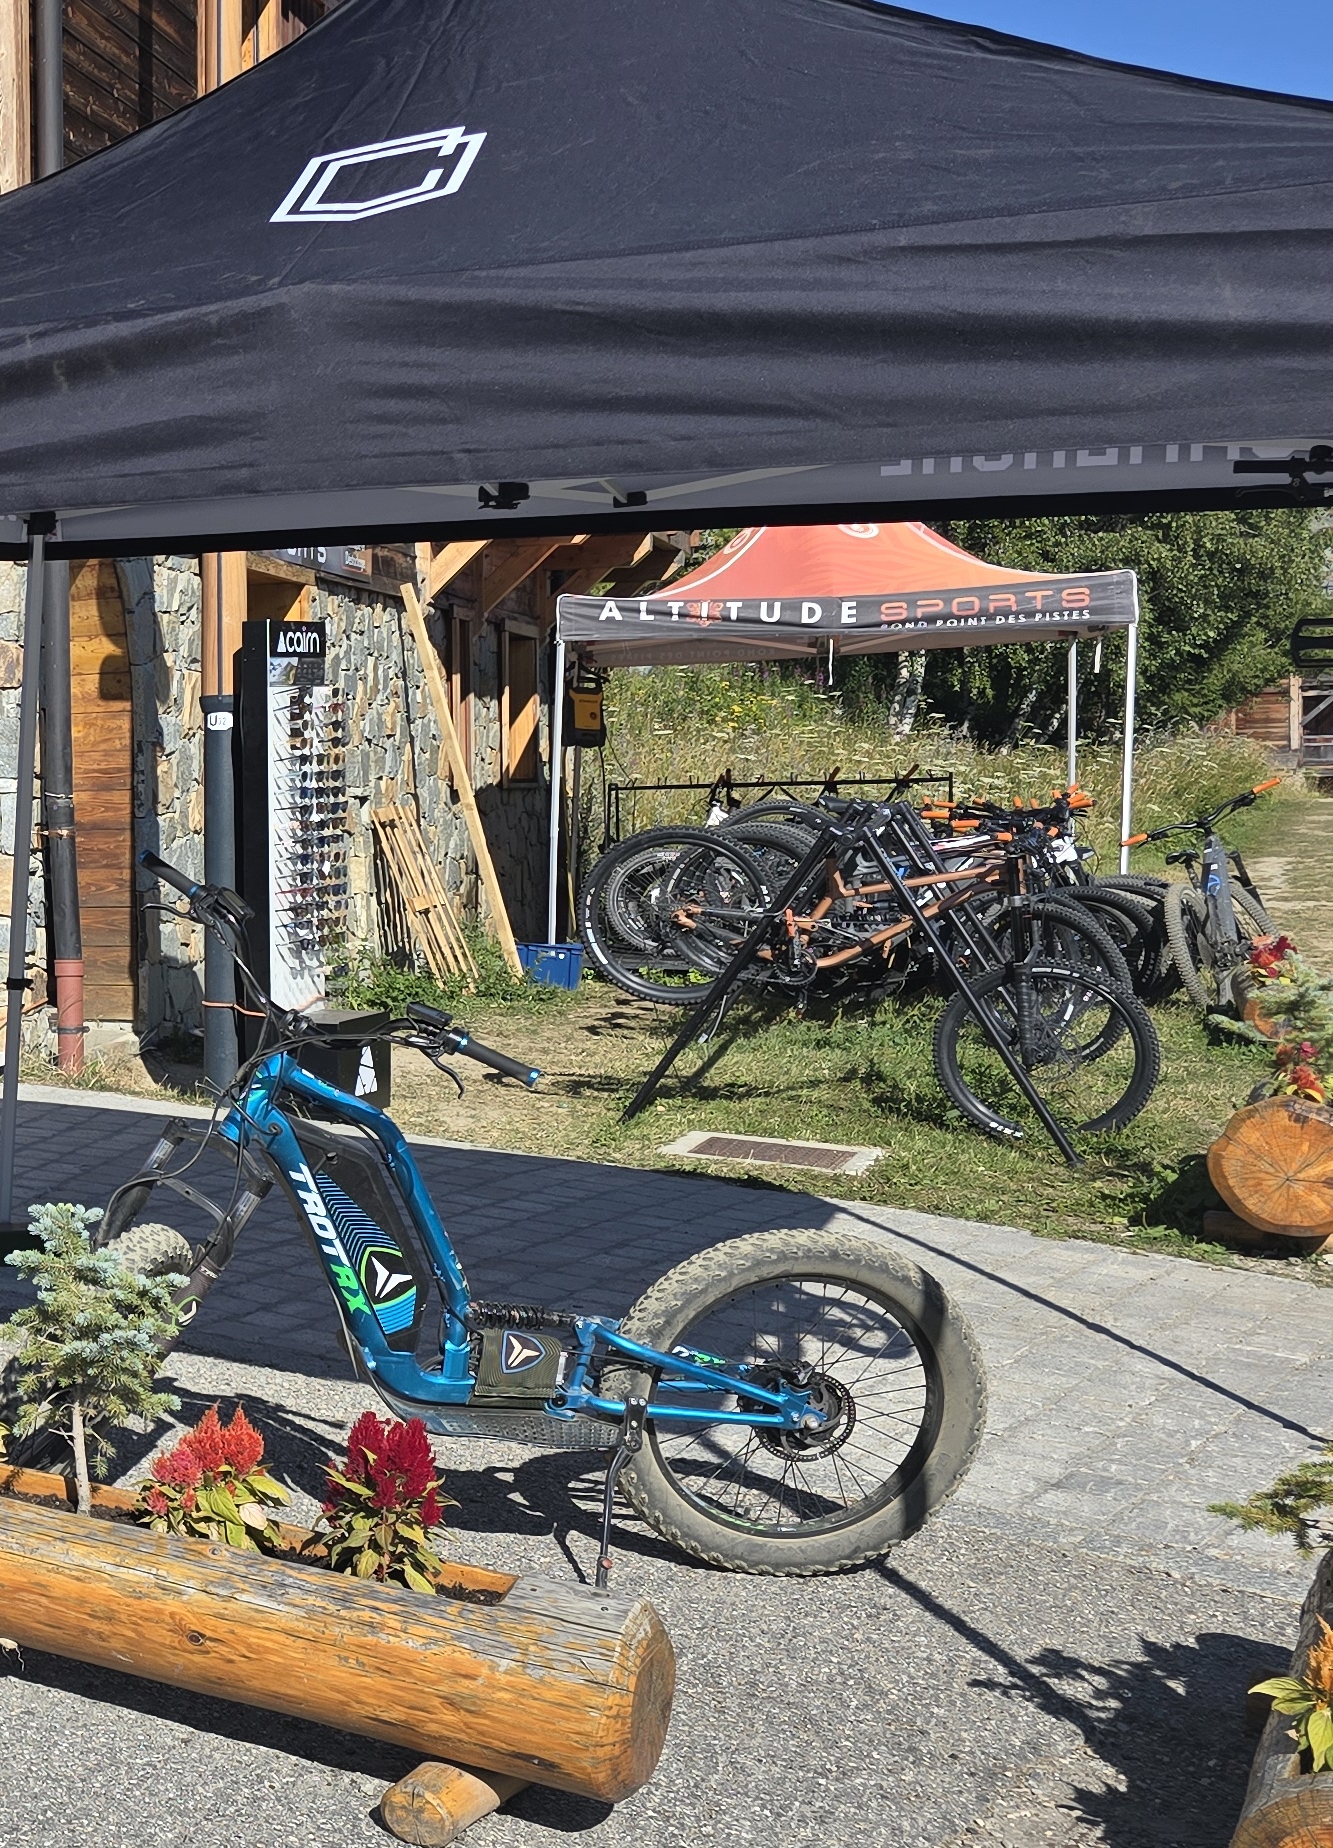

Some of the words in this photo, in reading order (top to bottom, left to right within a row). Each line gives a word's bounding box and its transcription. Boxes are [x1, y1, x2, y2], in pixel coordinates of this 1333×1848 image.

[598, 600, 859, 625] ALTITUDE
[879, 586, 1091, 623] SPORTS
[935, 615, 987, 628] POINT
[994, 613, 1027, 625] DES
[1034, 609, 1091, 622] PISTES
[285, 625, 321, 653] cairn
